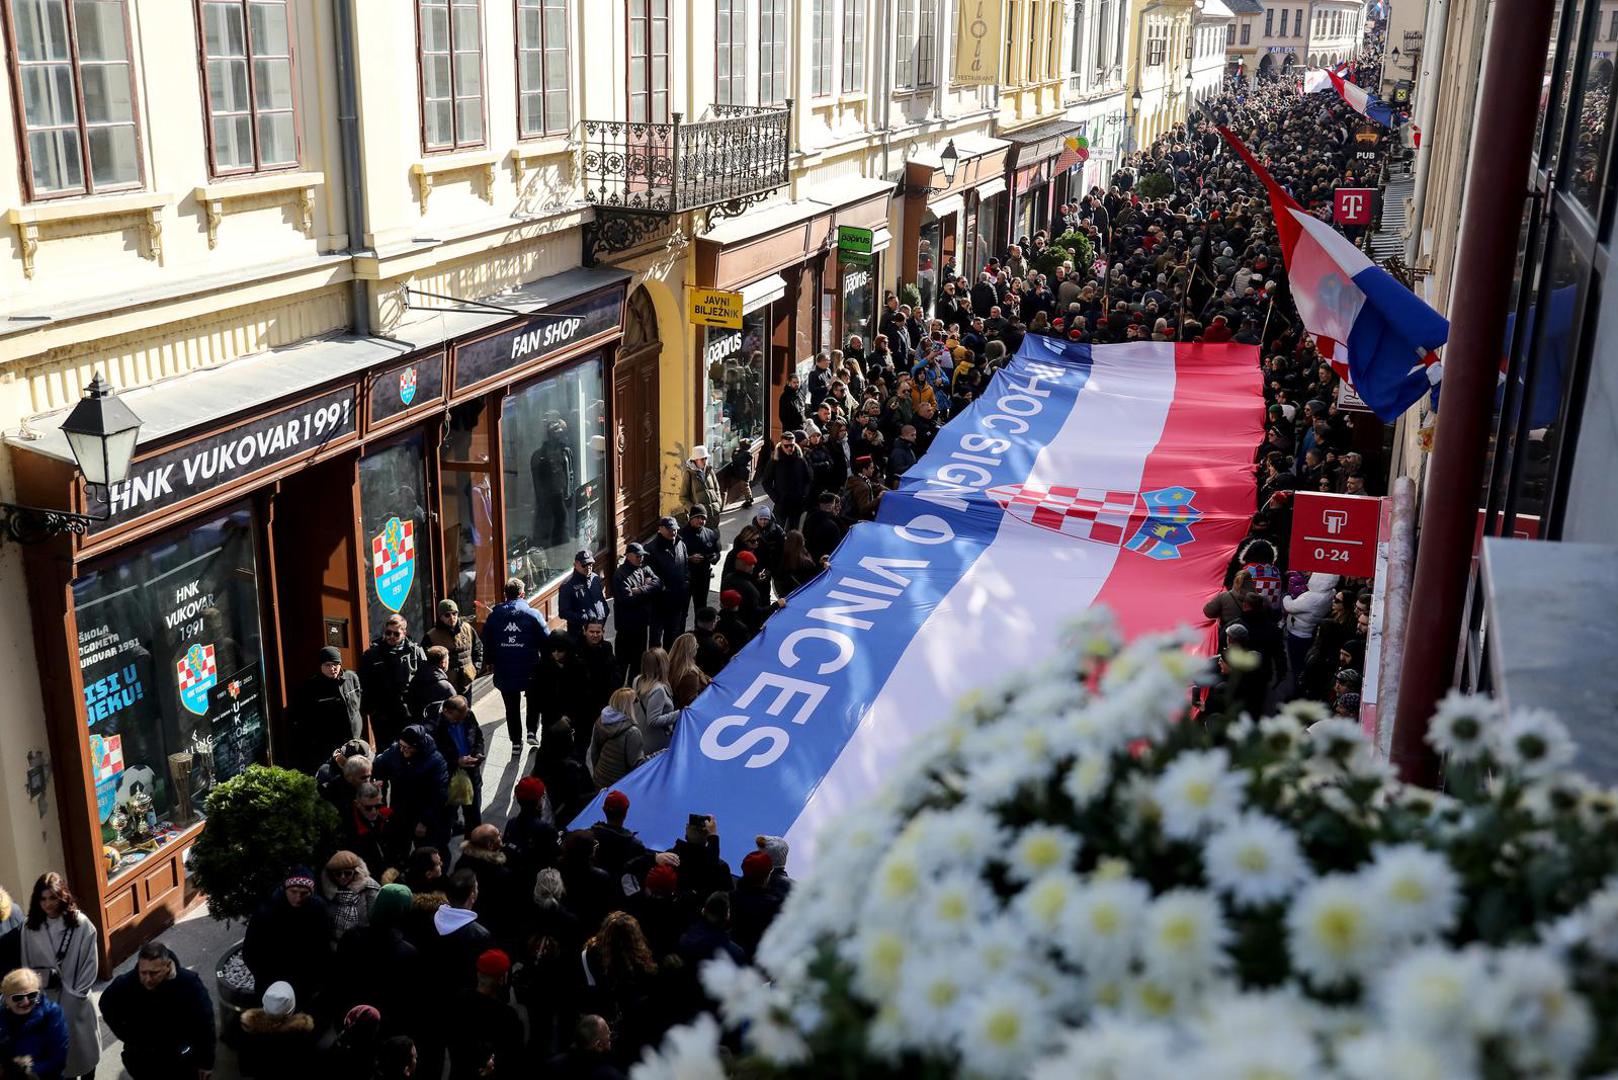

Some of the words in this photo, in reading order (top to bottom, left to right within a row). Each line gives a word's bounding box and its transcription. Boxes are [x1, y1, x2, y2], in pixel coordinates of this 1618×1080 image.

[1356, 152, 1375, 160] PUB
[1342, 195, 1363, 219] T
[841, 233, 870, 244] papirus
[845, 271, 867, 298] papirus
[694, 304, 739, 319] BILJEŽNIK
[704, 295, 730, 306] JAVNI
[511, 330, 540, 360] FAN
[543, 317, 581, 350] SHOP
[708, 332, 742, 370] papirus
[982, 373, 1060, 434] HOC
[110, 463, 174, 515] HNK
[1314, 548, 1350, 562] 0-24
[175, 580, 200, 604] HNK
[165, 594, 215, 630] VUKOVAR
[79, 624, 109, 643] ŠKOLA
[179, 618, 204, 643] 1991
[118, 638, 140, 653] 1991
[699, 556, 931, 769] VINCES
